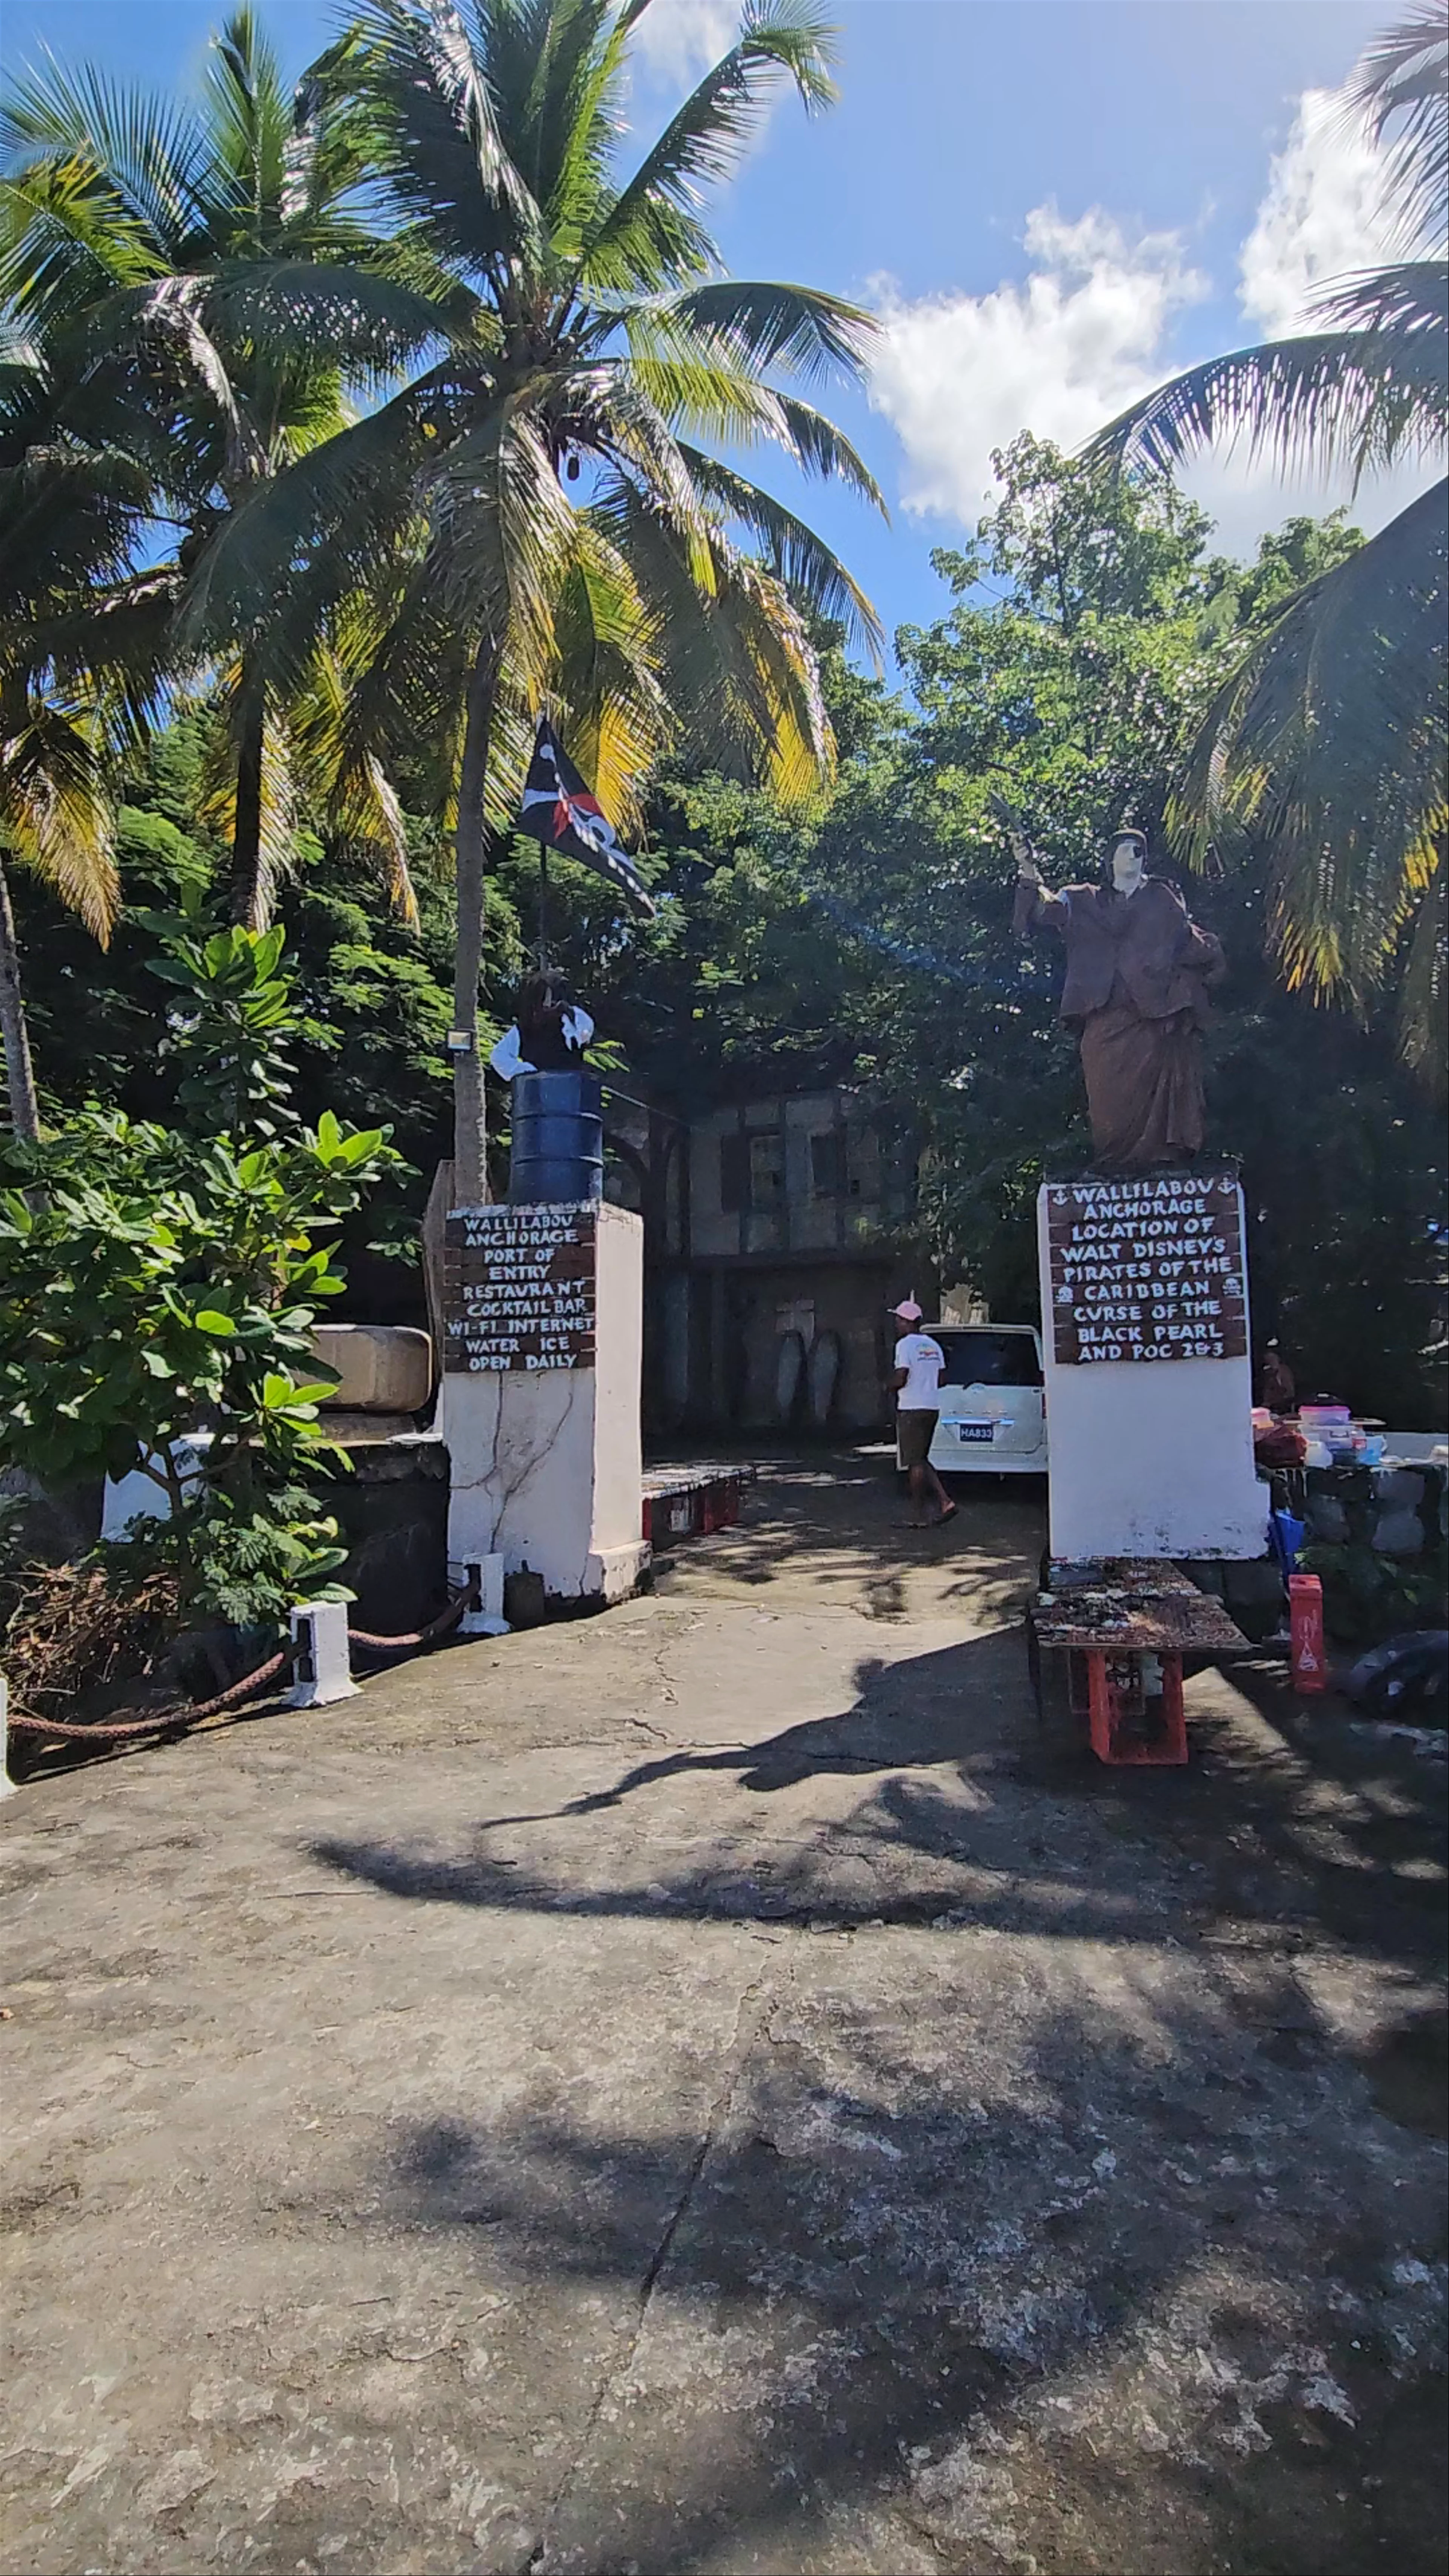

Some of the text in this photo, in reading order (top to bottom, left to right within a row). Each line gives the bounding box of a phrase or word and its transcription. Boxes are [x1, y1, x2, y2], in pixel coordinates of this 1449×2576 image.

[1083, 1199, 1206, 1220] ANCHORAGE
[464, 1215, 573, 1230] WALLILABOU
[1072, 1216, 1215, 1241] LOCATION OF
[466, 1230, 579, 1246] ANCHORAGE
[485, 1248, 555, 1264] PORT OF
[1060, 1236, 1226, 1262] WALT DISNEY'S
[489, 1264, 551, 1280] ENTRY
[1063, 1256, 1234, 1282] PIRATES OF THE
[463, 1281, 586, 1300] RESTAURANT
[1084, 1281, 1209, 1300] CARIBBEAN
[466, 1298, 586, 1316] COCKTAIL BAR
[1152, 1303, 1179, 1319] OF
[1181, 1300, 1222, 1316] THE
[448, 1318, 594, 1335] WI-FI INTERNET
[1078, 1323, 1223, 1343] BLACK PEARL
[466, 1336, 570, 1352] WATER ICE
[1078, 1345, 1122, 1360] AND
[1133, 1344, 1172, 1359] POC
[469, 1354, 577, 1371] OPEN DAILY
